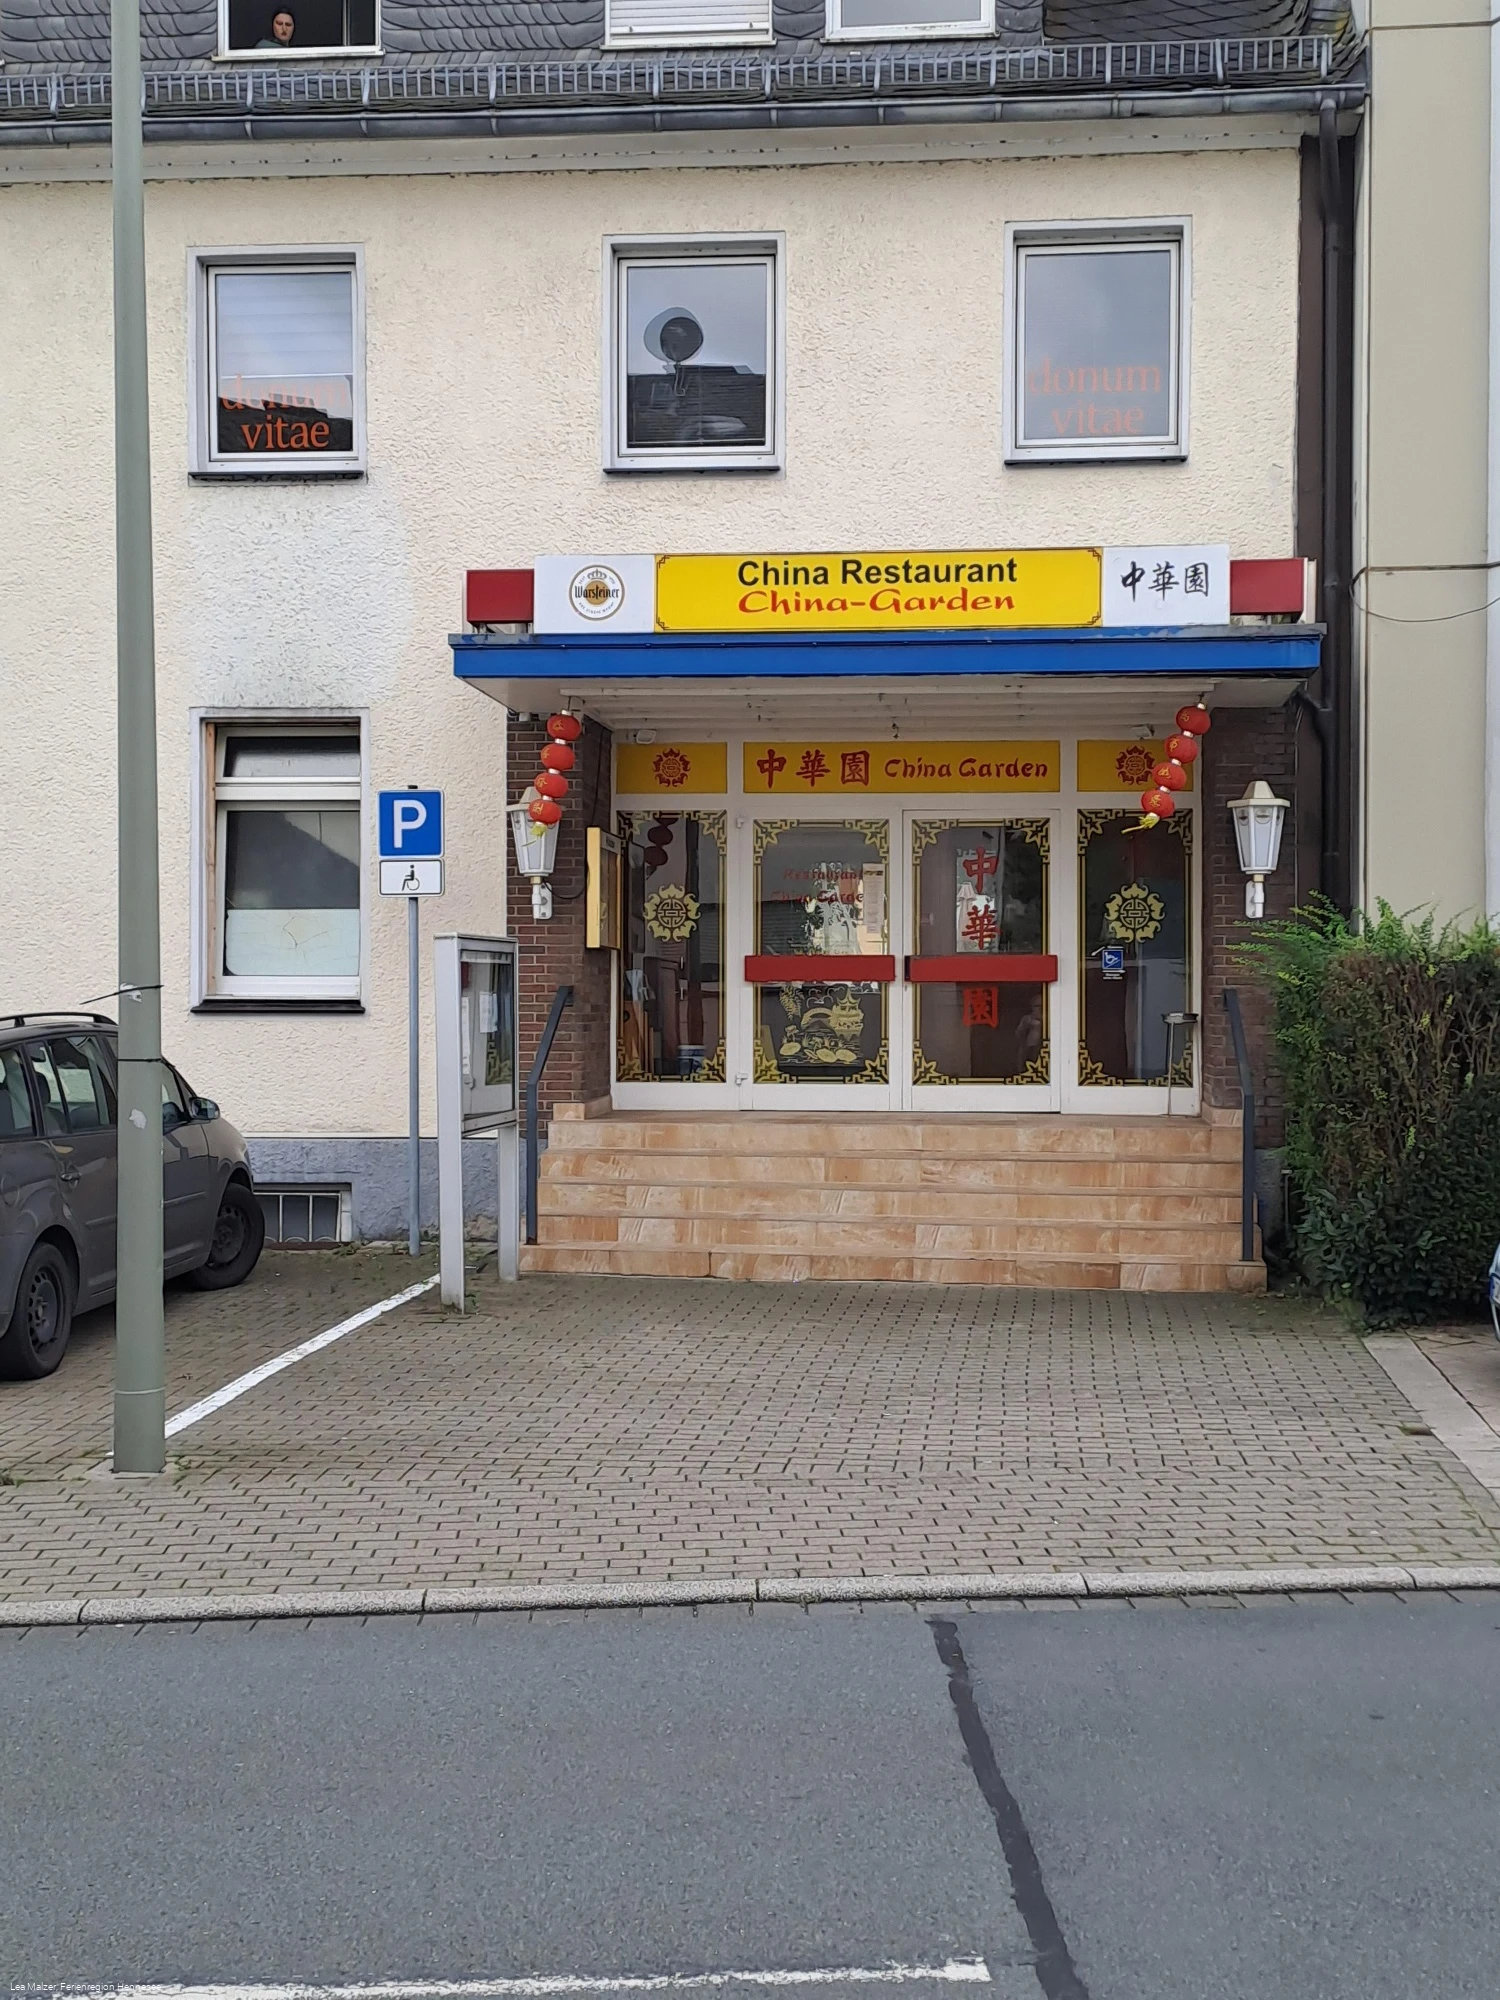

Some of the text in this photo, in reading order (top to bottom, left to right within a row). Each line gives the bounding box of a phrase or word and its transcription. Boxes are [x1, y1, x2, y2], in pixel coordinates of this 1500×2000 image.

[1028, 357, 1162, 397] donum
[241, 414, 330, 450] vitae
[1051, 402, 1145, 435] vitae
[737, 557, 1018, 587] China Restaurant
[1120, 560, 1209, 602] 中華園
[574, 584, 620, 600] Warsteiner
[738, 587, 1015, 615] China-Garden
[756, 748, 871, 789] 中華園
[884, 757, 1048, 779] China Garden
[393, 799, 427, 848] P
[816, 889, 864, 905] Garde
